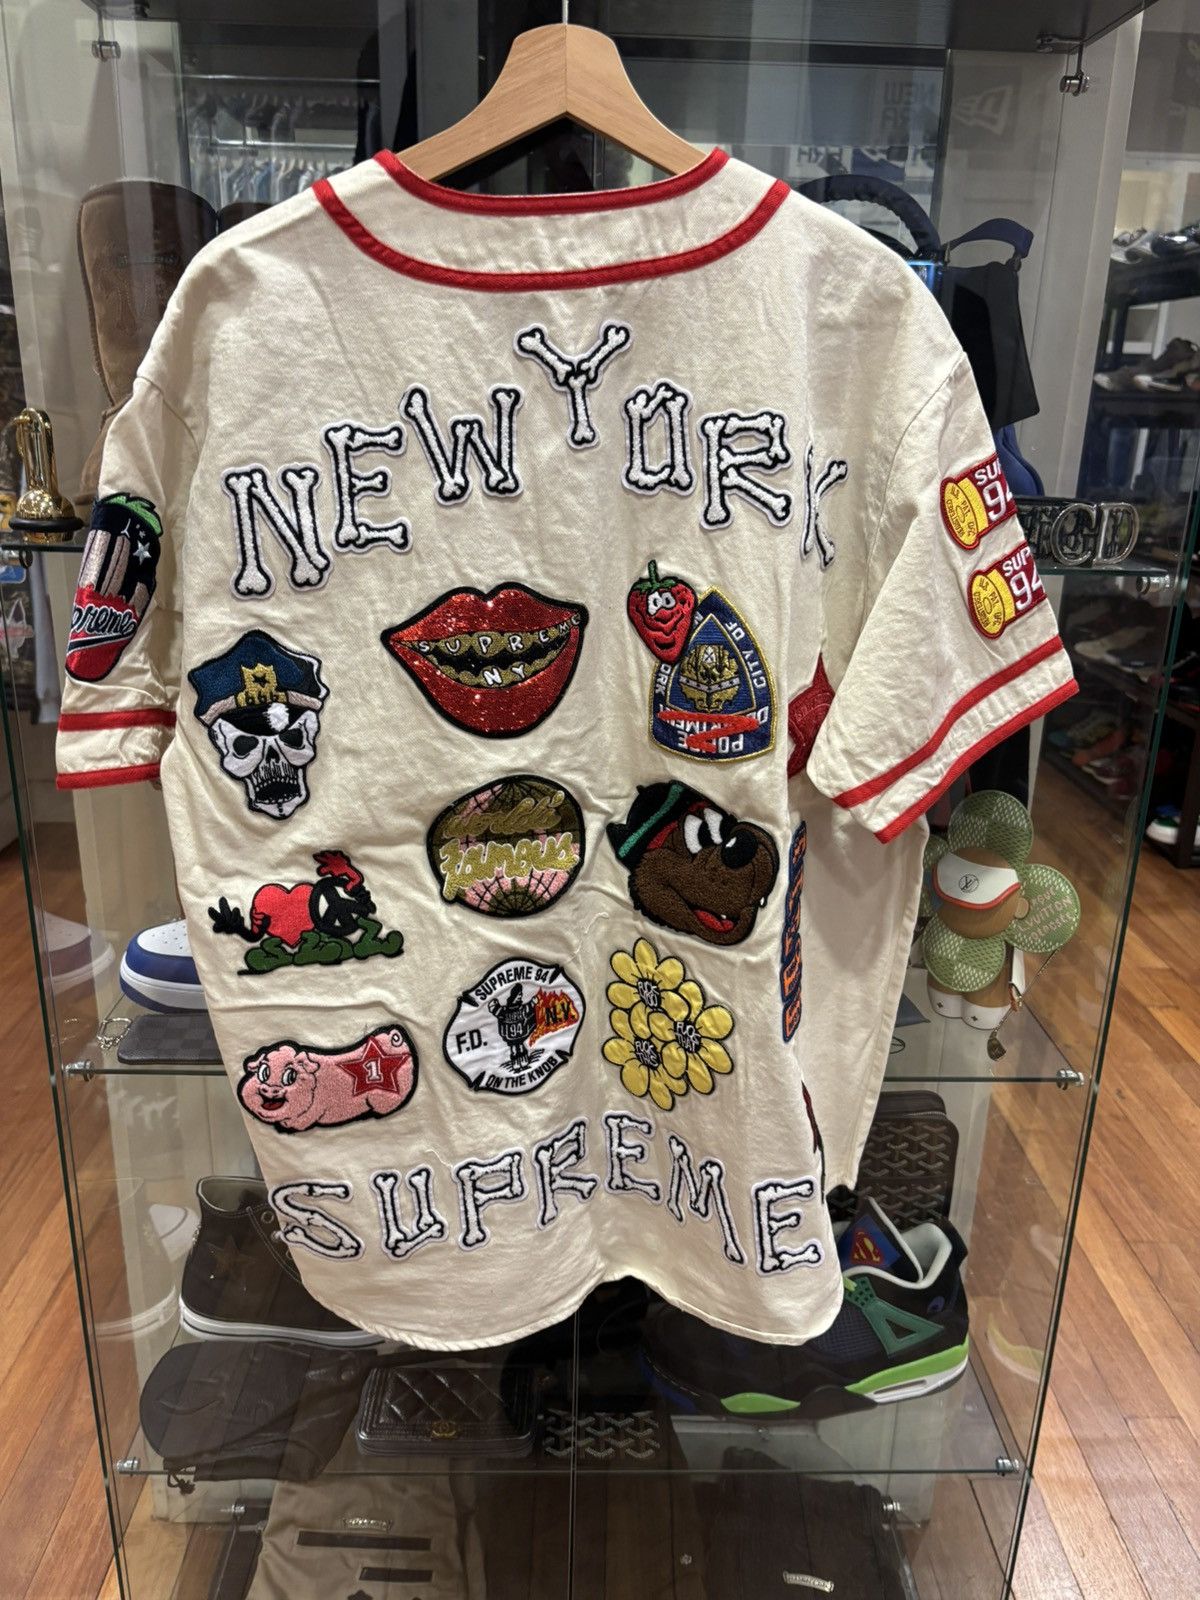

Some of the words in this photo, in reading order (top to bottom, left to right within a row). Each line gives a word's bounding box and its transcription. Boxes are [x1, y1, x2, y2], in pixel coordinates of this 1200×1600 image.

[223, 384, 523, 599] NEW
[514, 320, 849, 570] YORK
[417, 613, 581, 655] SUPREME
[725, 621, 746, 641] OF
[483, 664, 526, 687] NY
[743, 650, 767, 689] CITY
[475, 966, 534, 1002] SUPREME
[534, 967, 550, 983] 94
[455, 1029, 488, 1055] F.D.
[509, 1022, 523, 1038] 94
[362, 1060, 382, 1084] 1
[486, 1074, 502, 1089] ON
[504, 1075, 527, 1089] THE
[528, 1055, 559, 1083] KNOB
[268, 1110, 826, 1277] SUPREME
